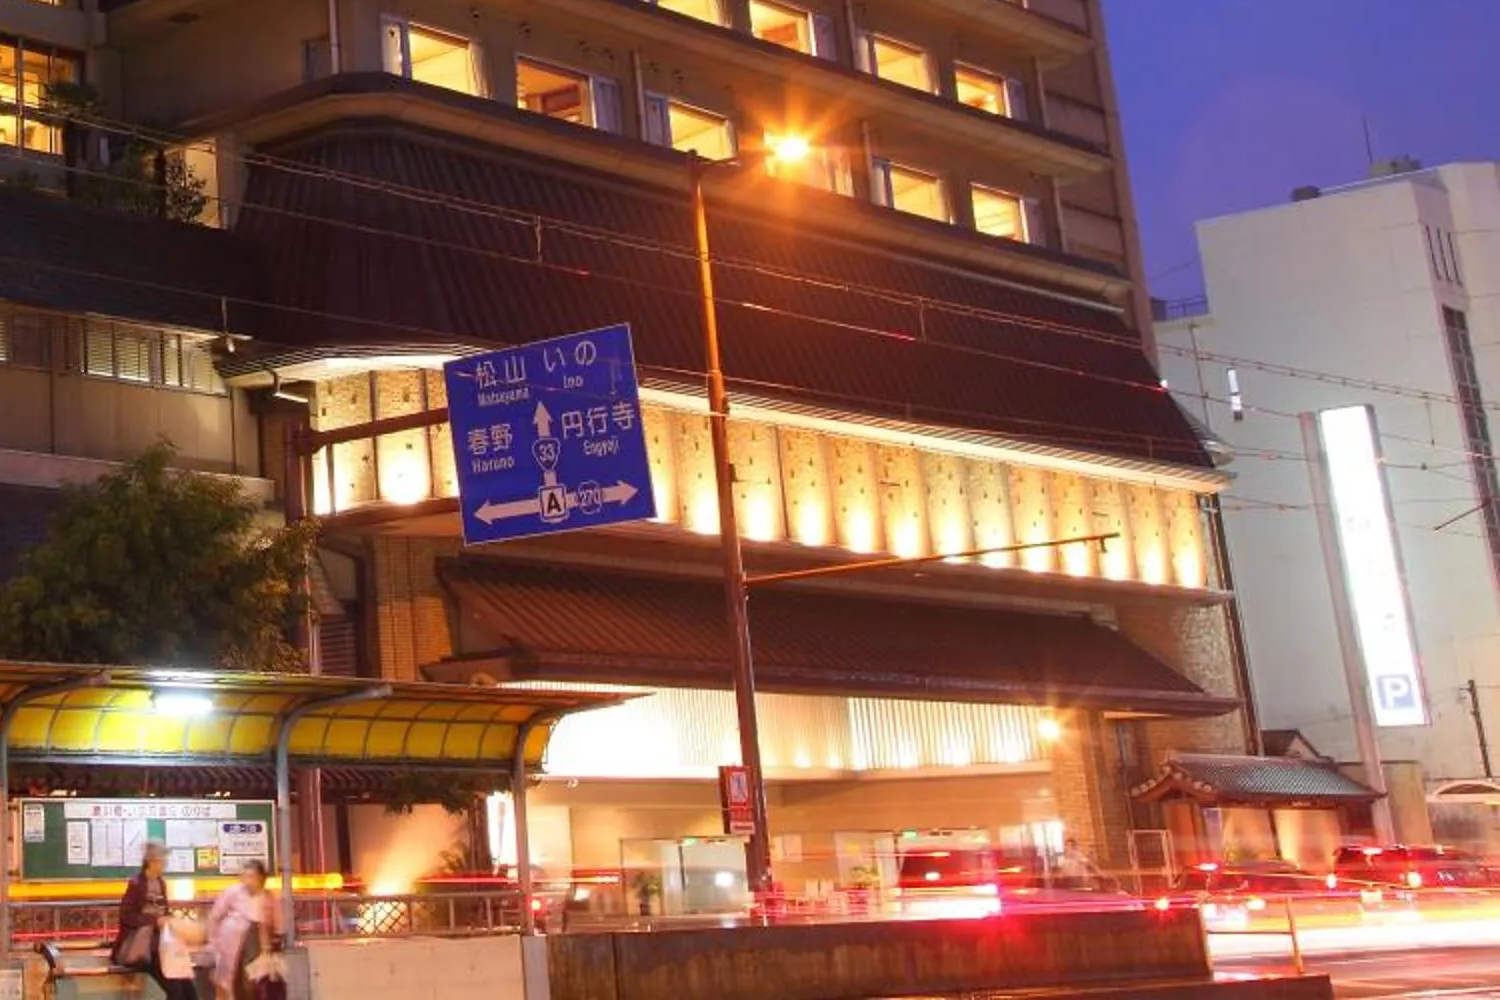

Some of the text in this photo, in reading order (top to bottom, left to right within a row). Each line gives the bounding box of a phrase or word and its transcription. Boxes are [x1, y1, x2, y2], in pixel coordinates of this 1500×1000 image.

[475, 340, 597, 389] 松山 いの
[477, 375, 583, 407] Matsuyama Ino
[560, 401, 635, 439] 円行寺
[467, 423, 514, 455] 春野
[540, 443, 555, 462] 33
[471, 456, 515, 474] Haruno
[547, 490, 562, 514] A
[580, 487, 601, 506] 270
[1382, 677, 1409, 708] P
